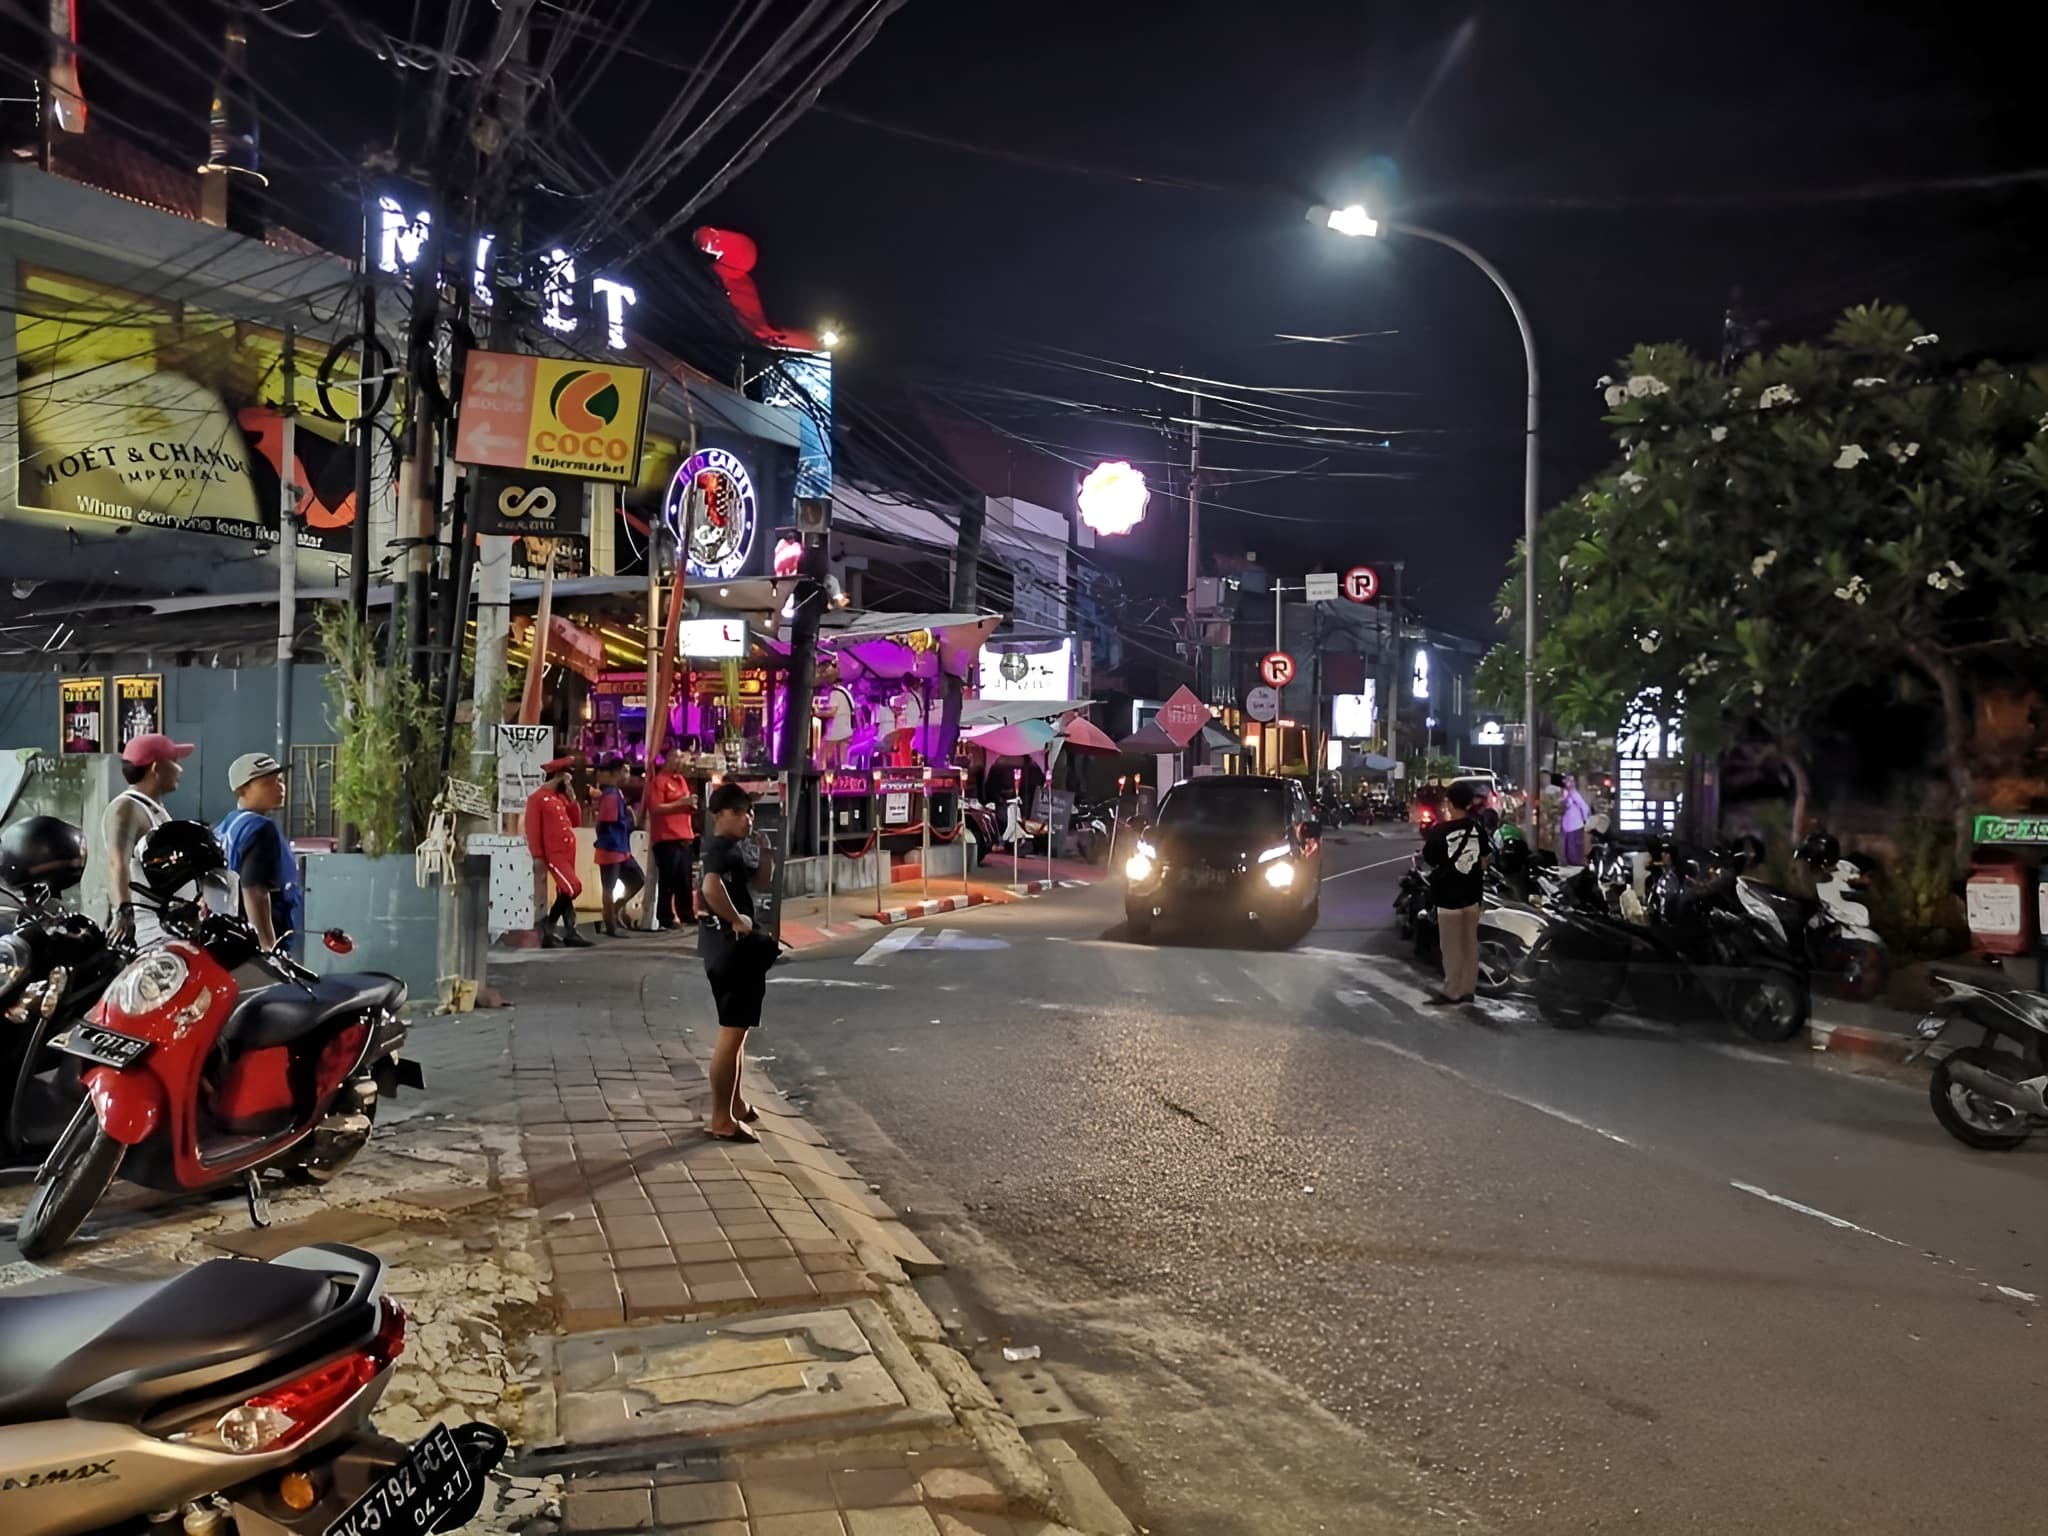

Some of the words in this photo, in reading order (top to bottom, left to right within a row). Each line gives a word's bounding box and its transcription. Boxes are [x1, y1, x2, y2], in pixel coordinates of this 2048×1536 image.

[472, 360, 526, 399] 24
[128, 447, 145, 463] &
[535, 430, 629, 461] COCO
[532, 454, 625, 475] Supermarket
[119, 467, 227, 484] IMPERIAL
